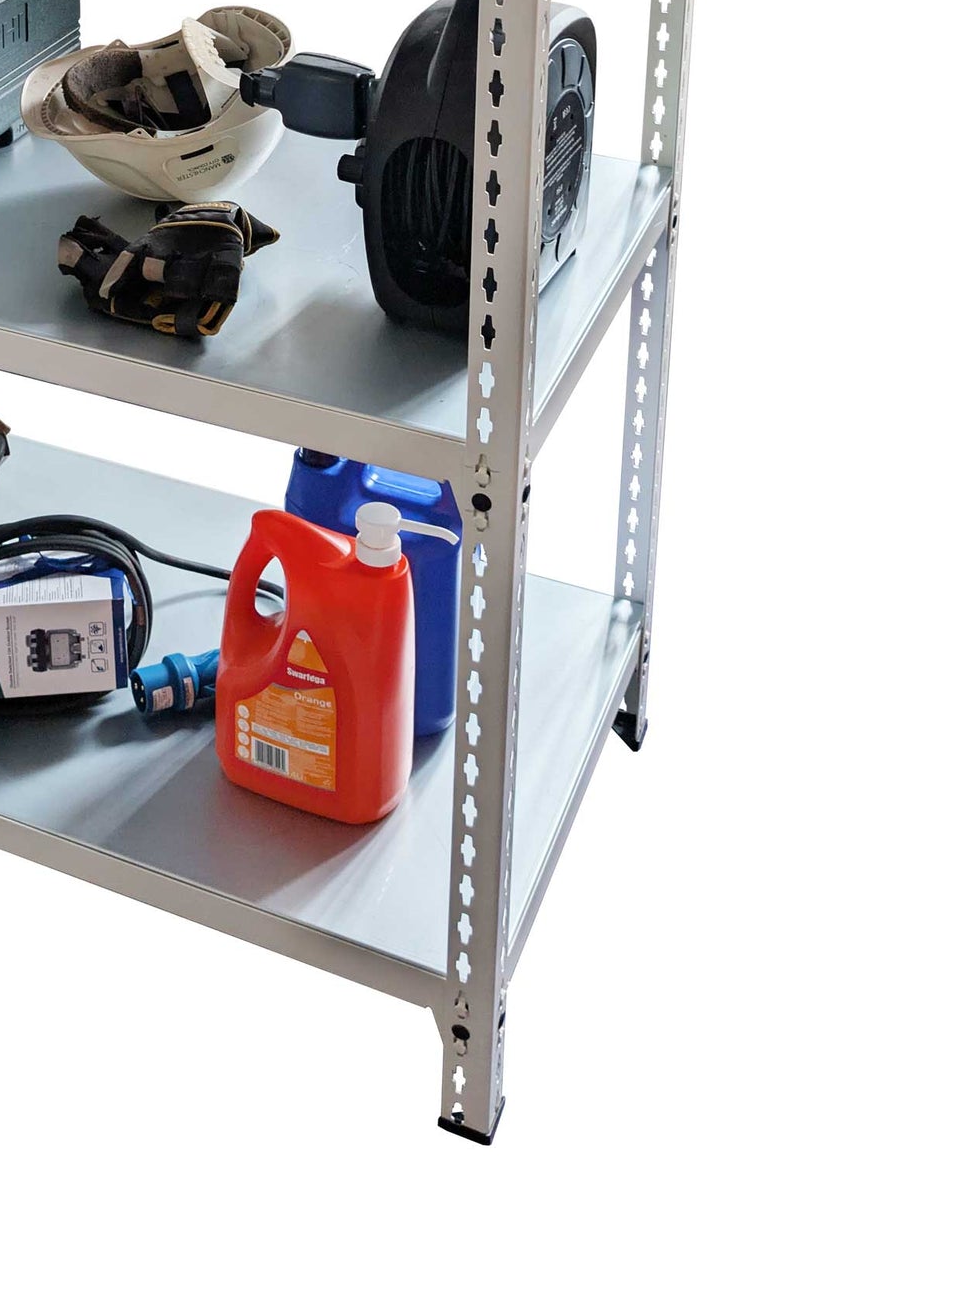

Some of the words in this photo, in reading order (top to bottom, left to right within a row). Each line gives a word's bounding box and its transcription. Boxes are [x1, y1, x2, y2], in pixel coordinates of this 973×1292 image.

[176, 162, 221, 181] MANCHESTER
[287, 666, 326, 685] Swarfega
[294, 691, 332, 708] Orange
